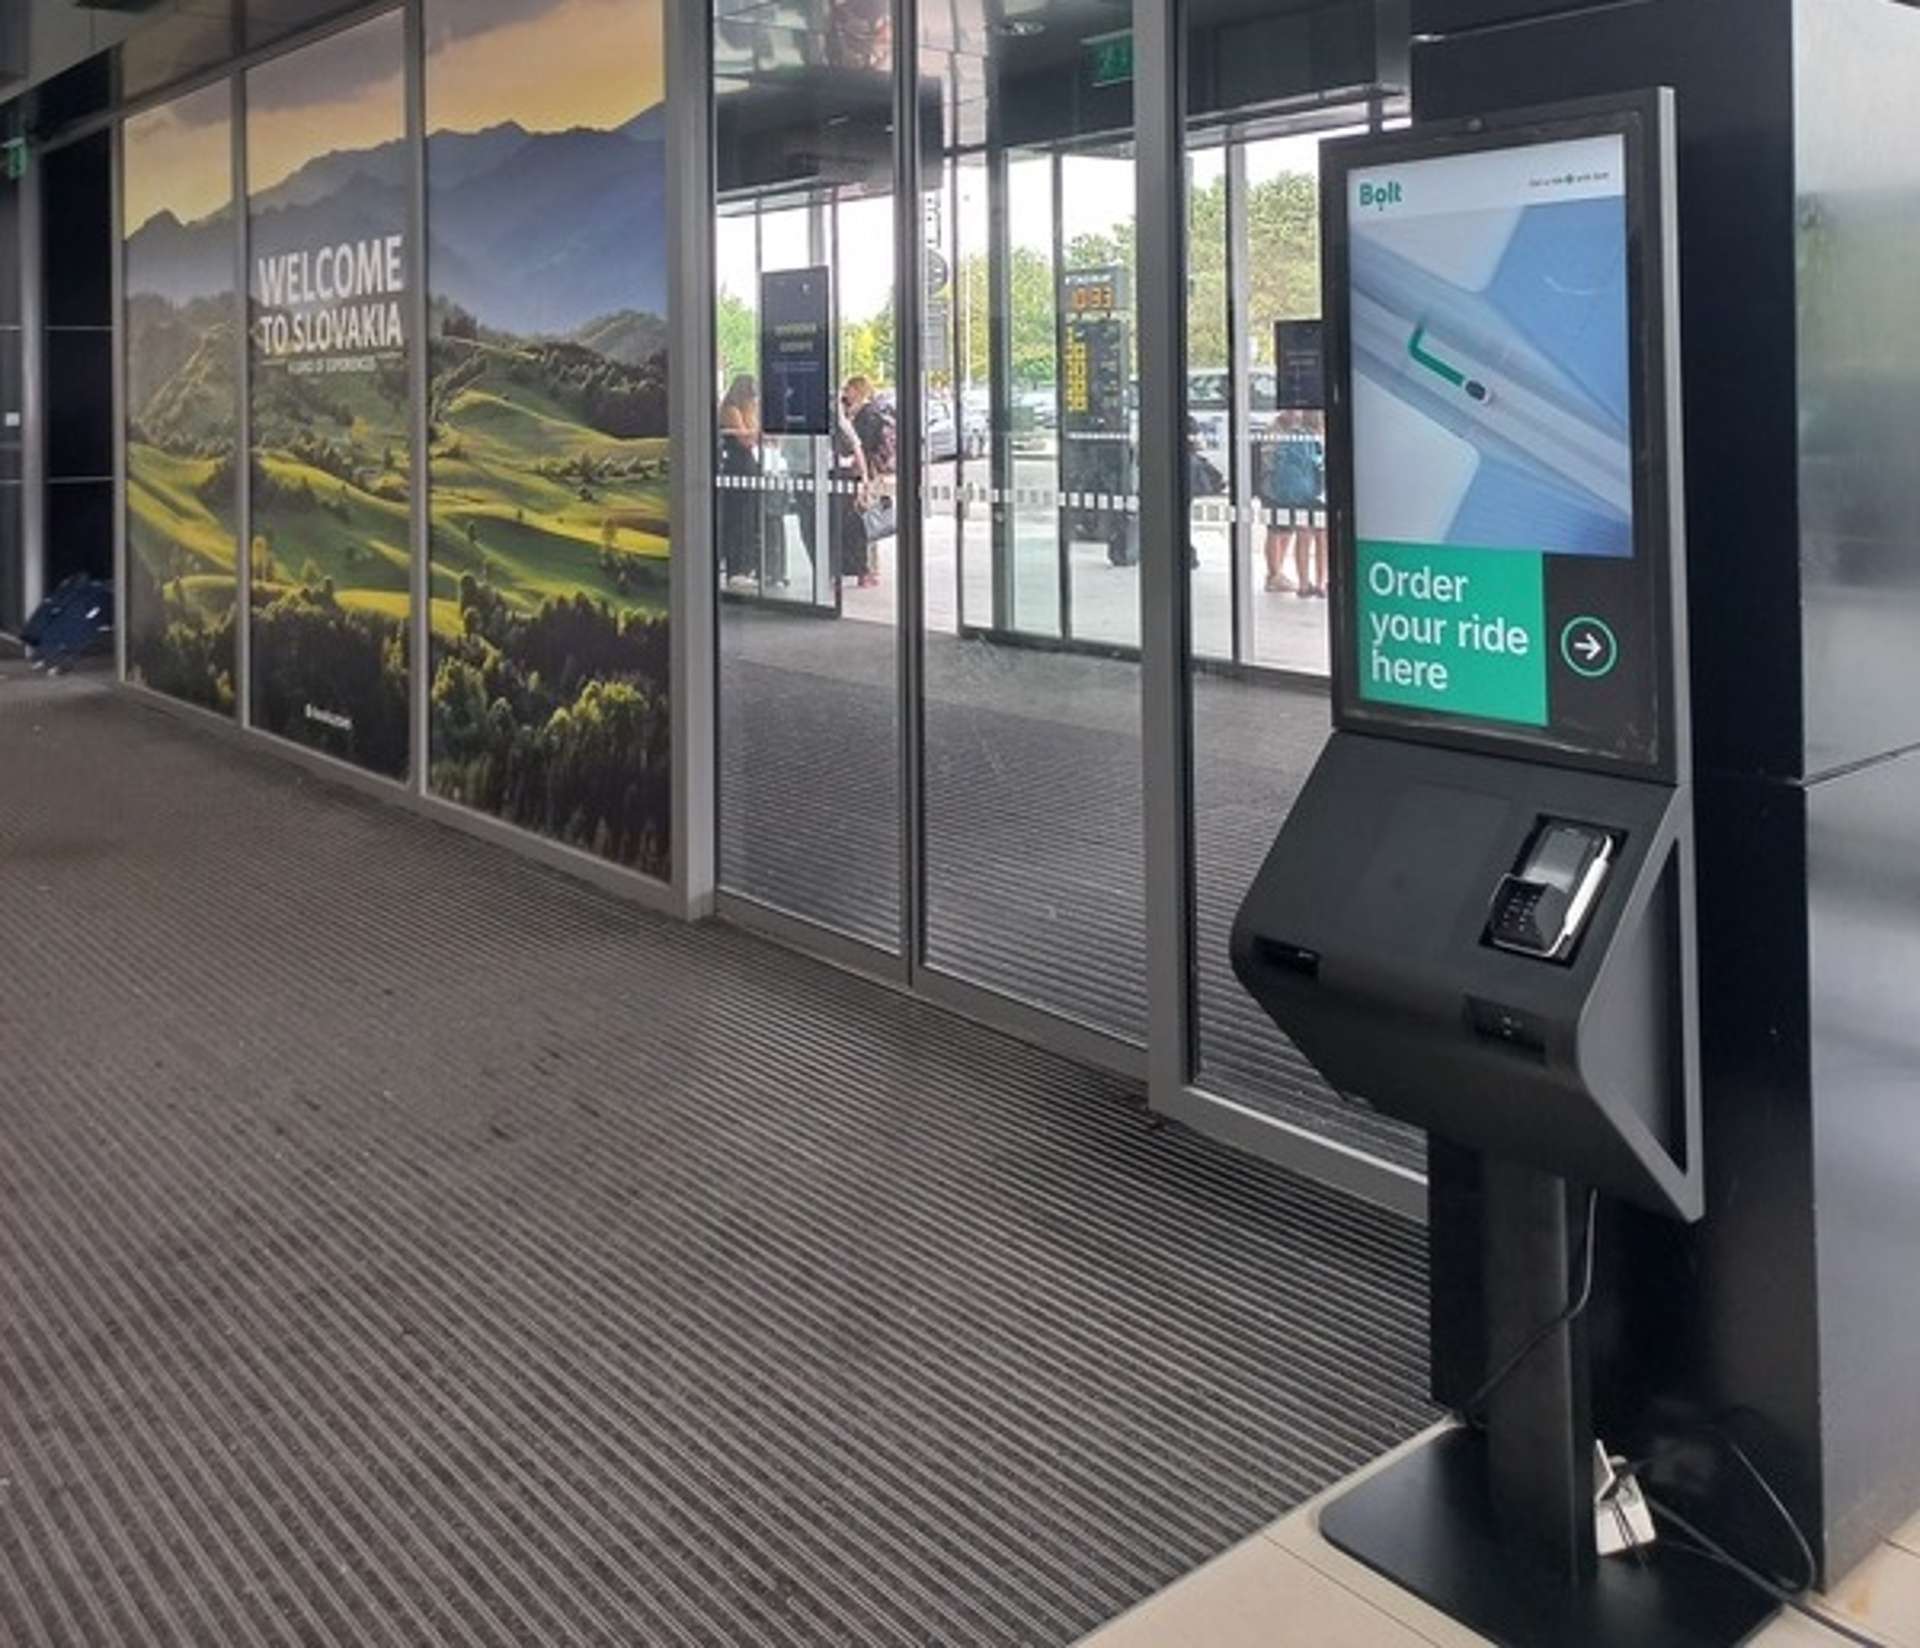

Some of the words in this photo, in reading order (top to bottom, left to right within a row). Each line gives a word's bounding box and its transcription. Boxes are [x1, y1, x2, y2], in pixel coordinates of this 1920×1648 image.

[1360, 181, 1402, 211] Bolt
[258, 234, 403, 307] WELCOME
[258, 314, 289, 355] TO
[293, 301, 403, 352] SLOVAKIA
[1369, 562, 1469, 602] Order
[1369, 611, 1447, 646] your
[1458, 613, 1529, 656] ride
[1371, 649, 1448, 690] here
